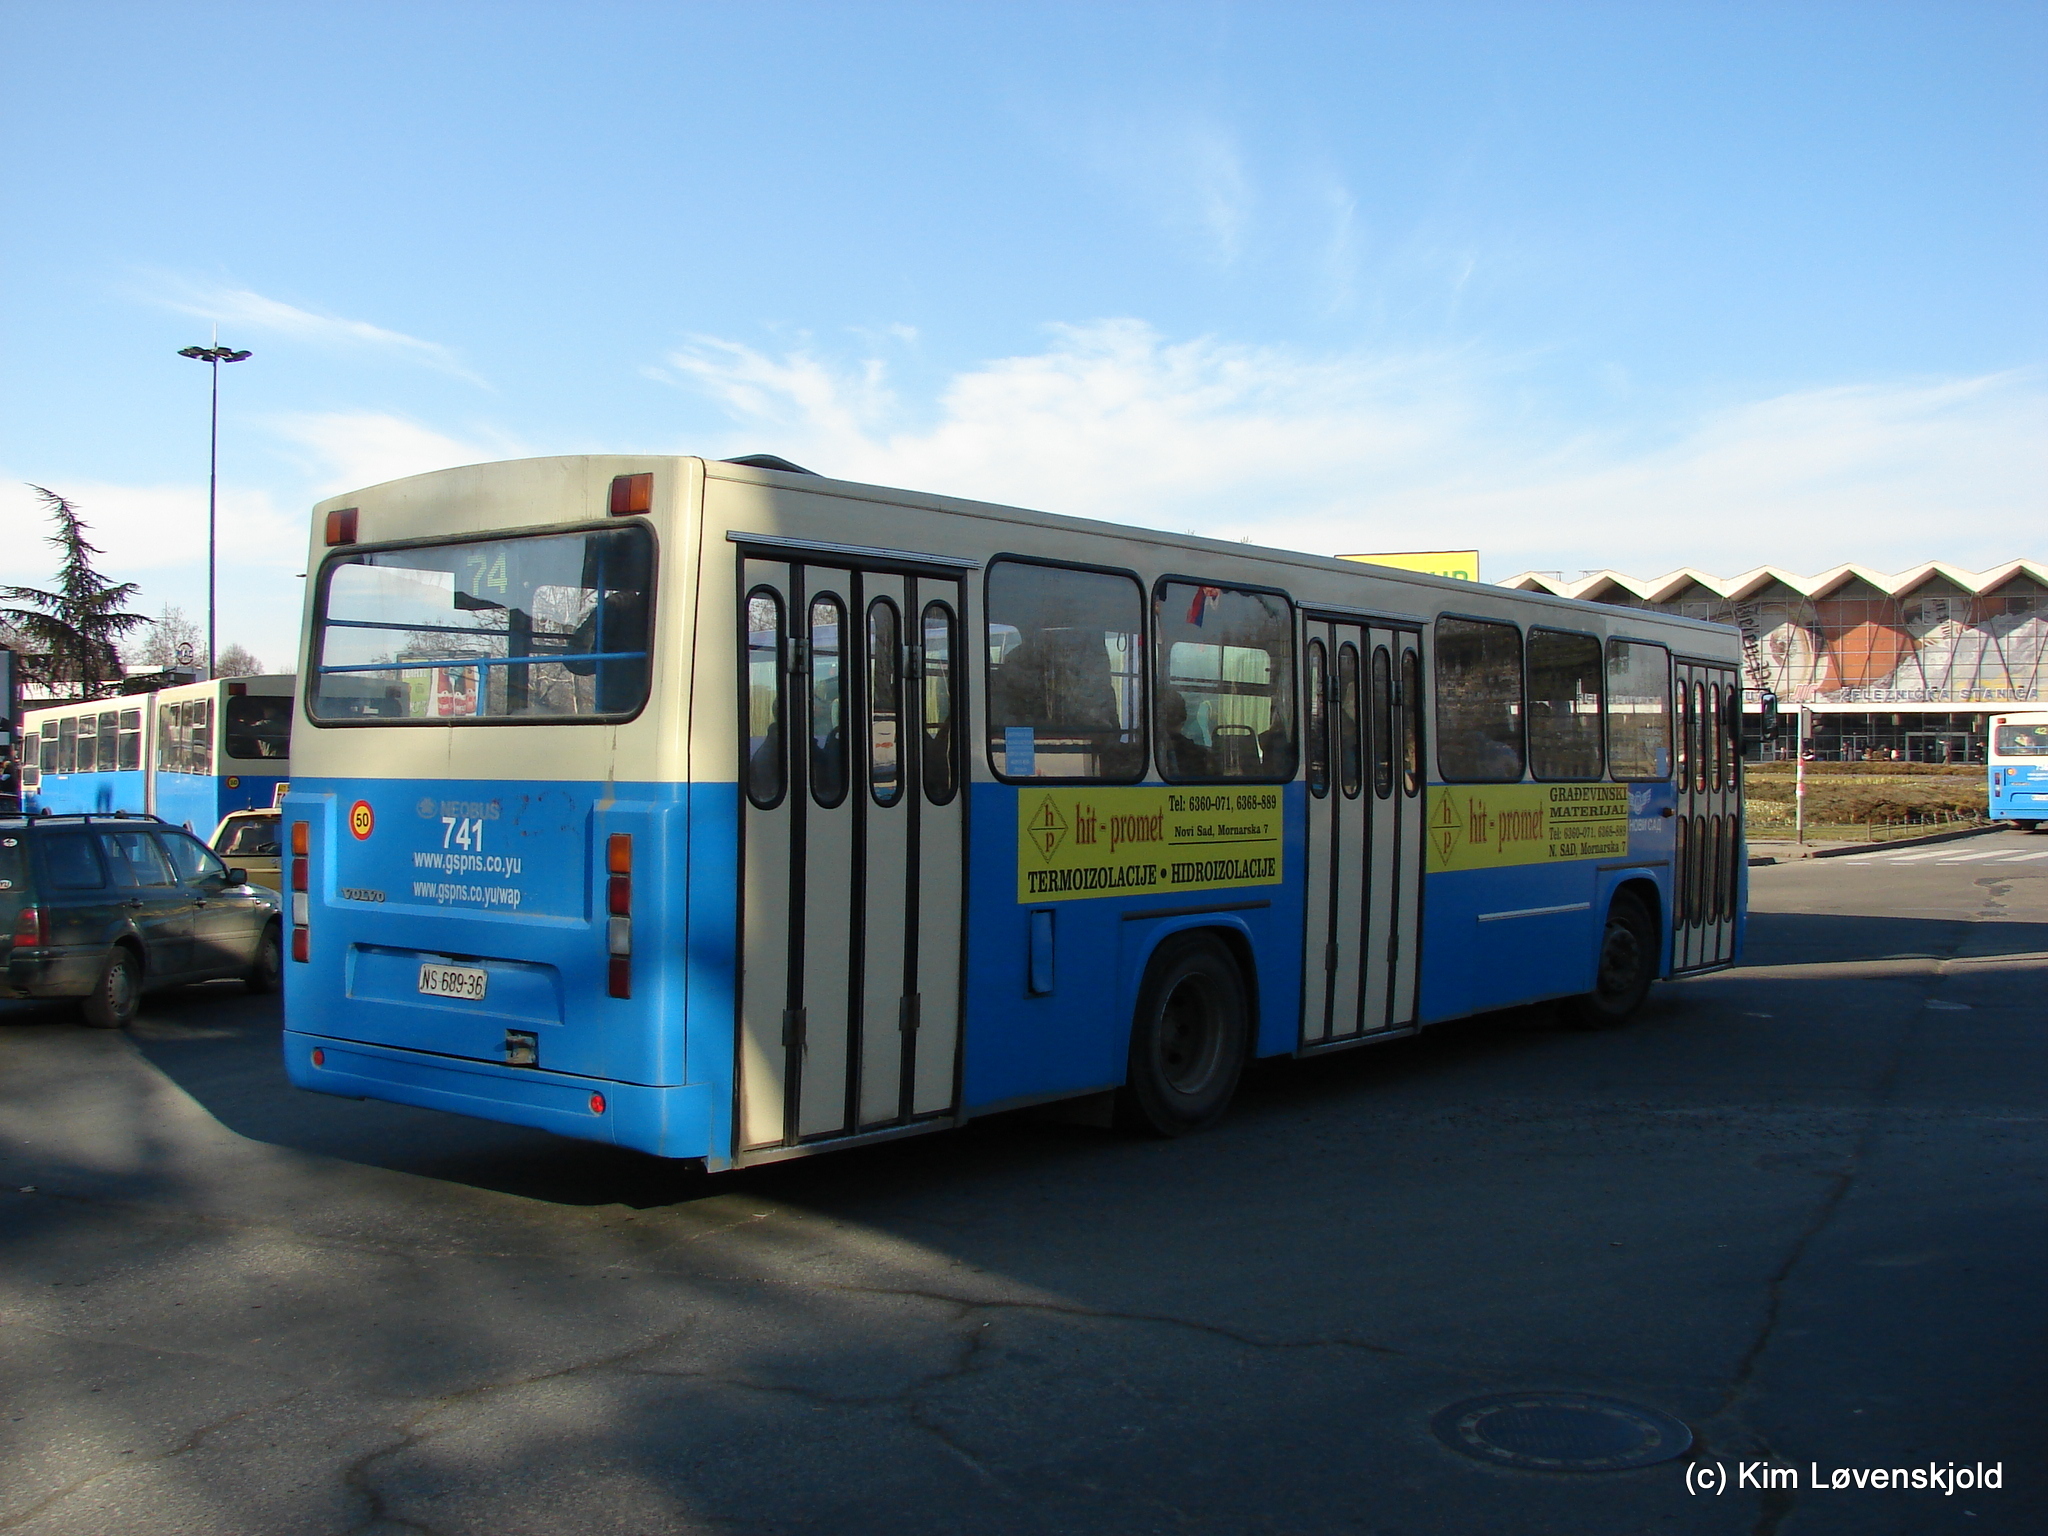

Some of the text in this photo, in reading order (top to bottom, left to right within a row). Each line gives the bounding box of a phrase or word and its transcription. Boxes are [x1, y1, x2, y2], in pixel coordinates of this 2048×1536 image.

[467, 551, 508, 596] 74
[1840, 686, 1950, 702] ŽELEZNIČKA
[1169, 795, 1277, 813] Tel: 6360-071, 6368-889
[1549, 787, 1627, 802] GRAĐEVINSKI
[355, 812, 369, 828] 50
[440, 800, 500, 820] NEOBUS
[1044, 804, 1054, 827] h
[1443, 799, 1452, 824] h
[1549, 805, 1627, 818] MATERIJAL
[442, 817, 484, 852] 741
[1076, 802, 1097, 845] hit
[1109, 806, 1164, 854] promet
[1174, 824, 1269, 838] Novi Sad, Mornarska 7
[1469, 797, 1488, 844] hit
[1498, 799, 1544, 853] promet
[1549, 827, 1562, 840] Tel:
[1045, 832, 1055, 853] p
[1443, 831, 1452, 854] p
[1549, 841, 1626, 857] N. SAD, Mornarska 7
[414, 851, 522, 878] www.gspns.co.yu
[1028, 857, 1276, 894] TERMOIZOLACIJE HIDROIZOLACIJE
[341, 888, 386, 903] VOLVO
[414, 882, 520, 909] www.gspns.co.yu/wap
[422, 969, 483, 996] NS 689-36
